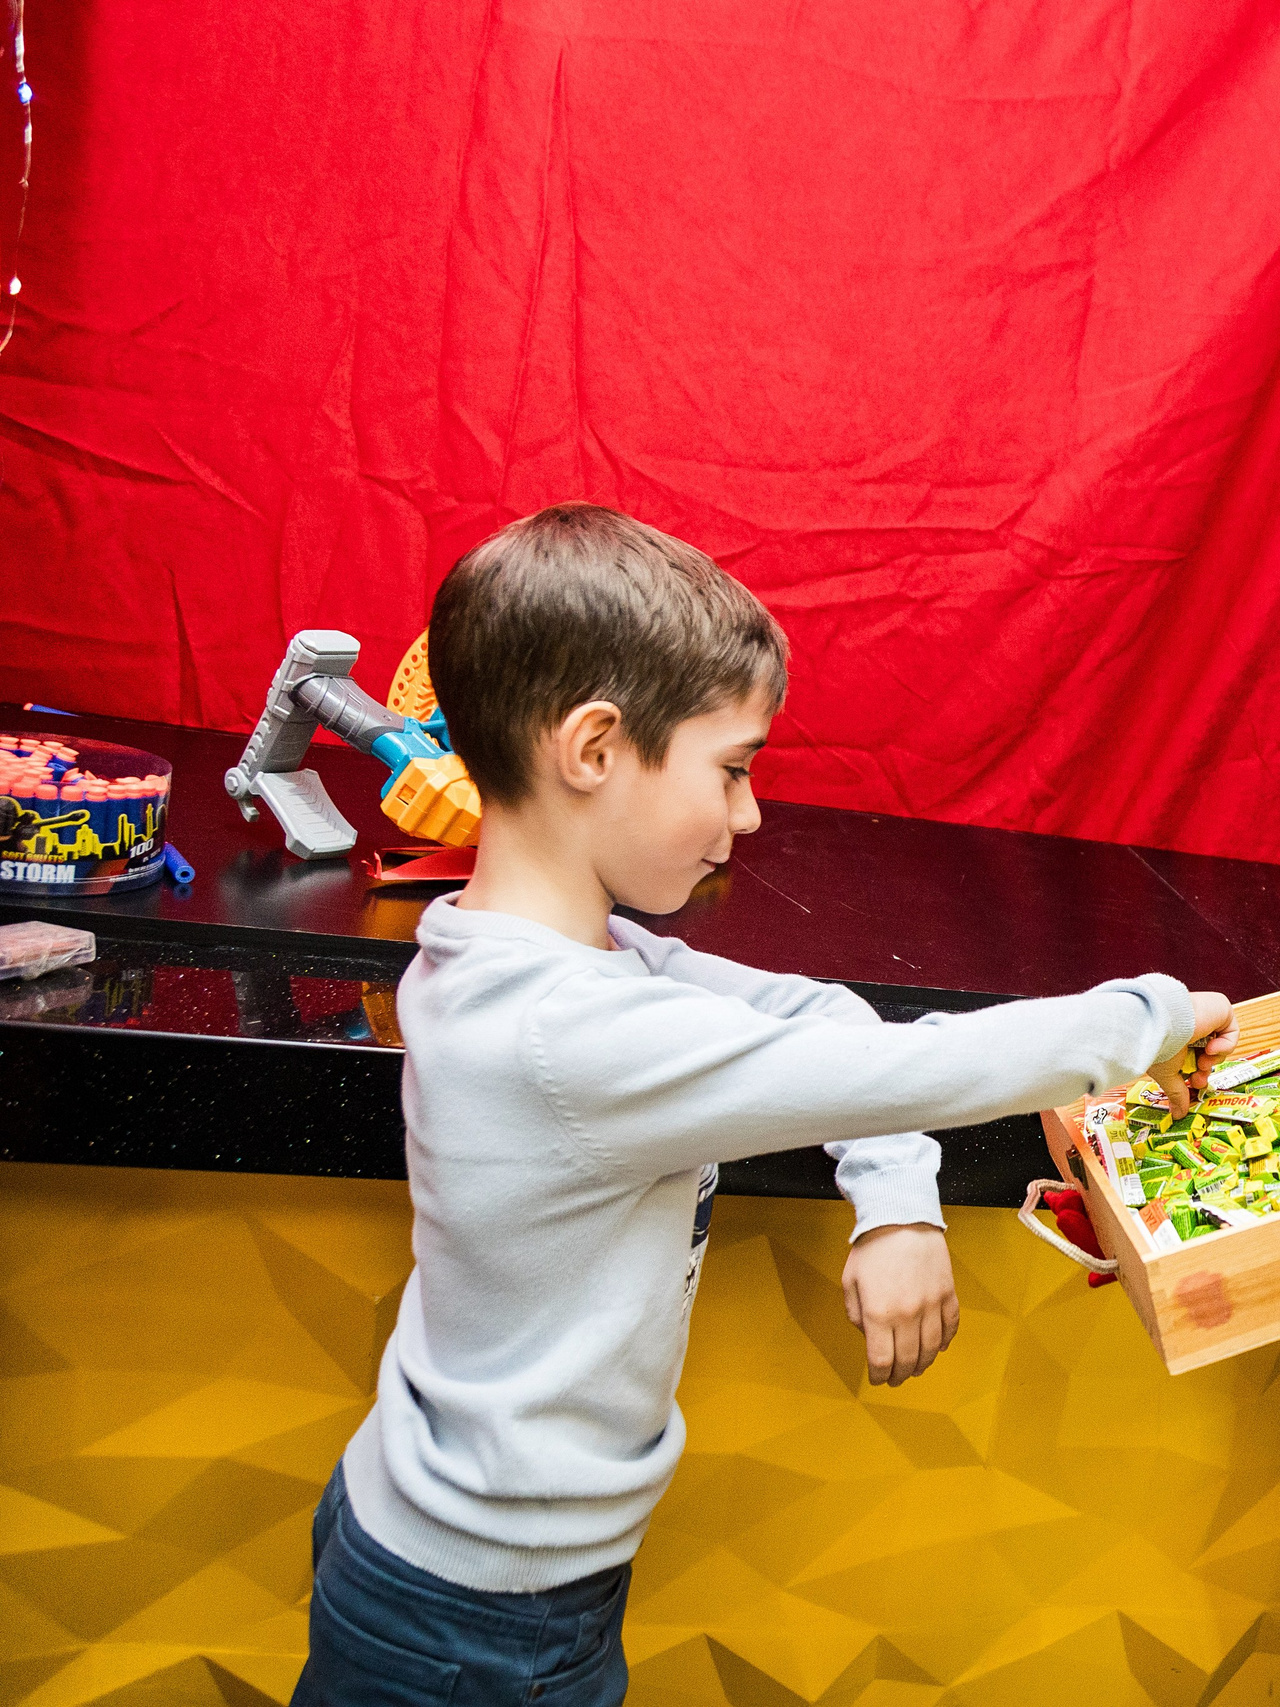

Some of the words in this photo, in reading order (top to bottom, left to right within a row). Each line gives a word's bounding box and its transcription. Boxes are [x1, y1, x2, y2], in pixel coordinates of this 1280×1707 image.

[1, 850, 25, 861] SOFT
[130, 838, 154, 858] 100
[1, 860, 76, 882] STORM
